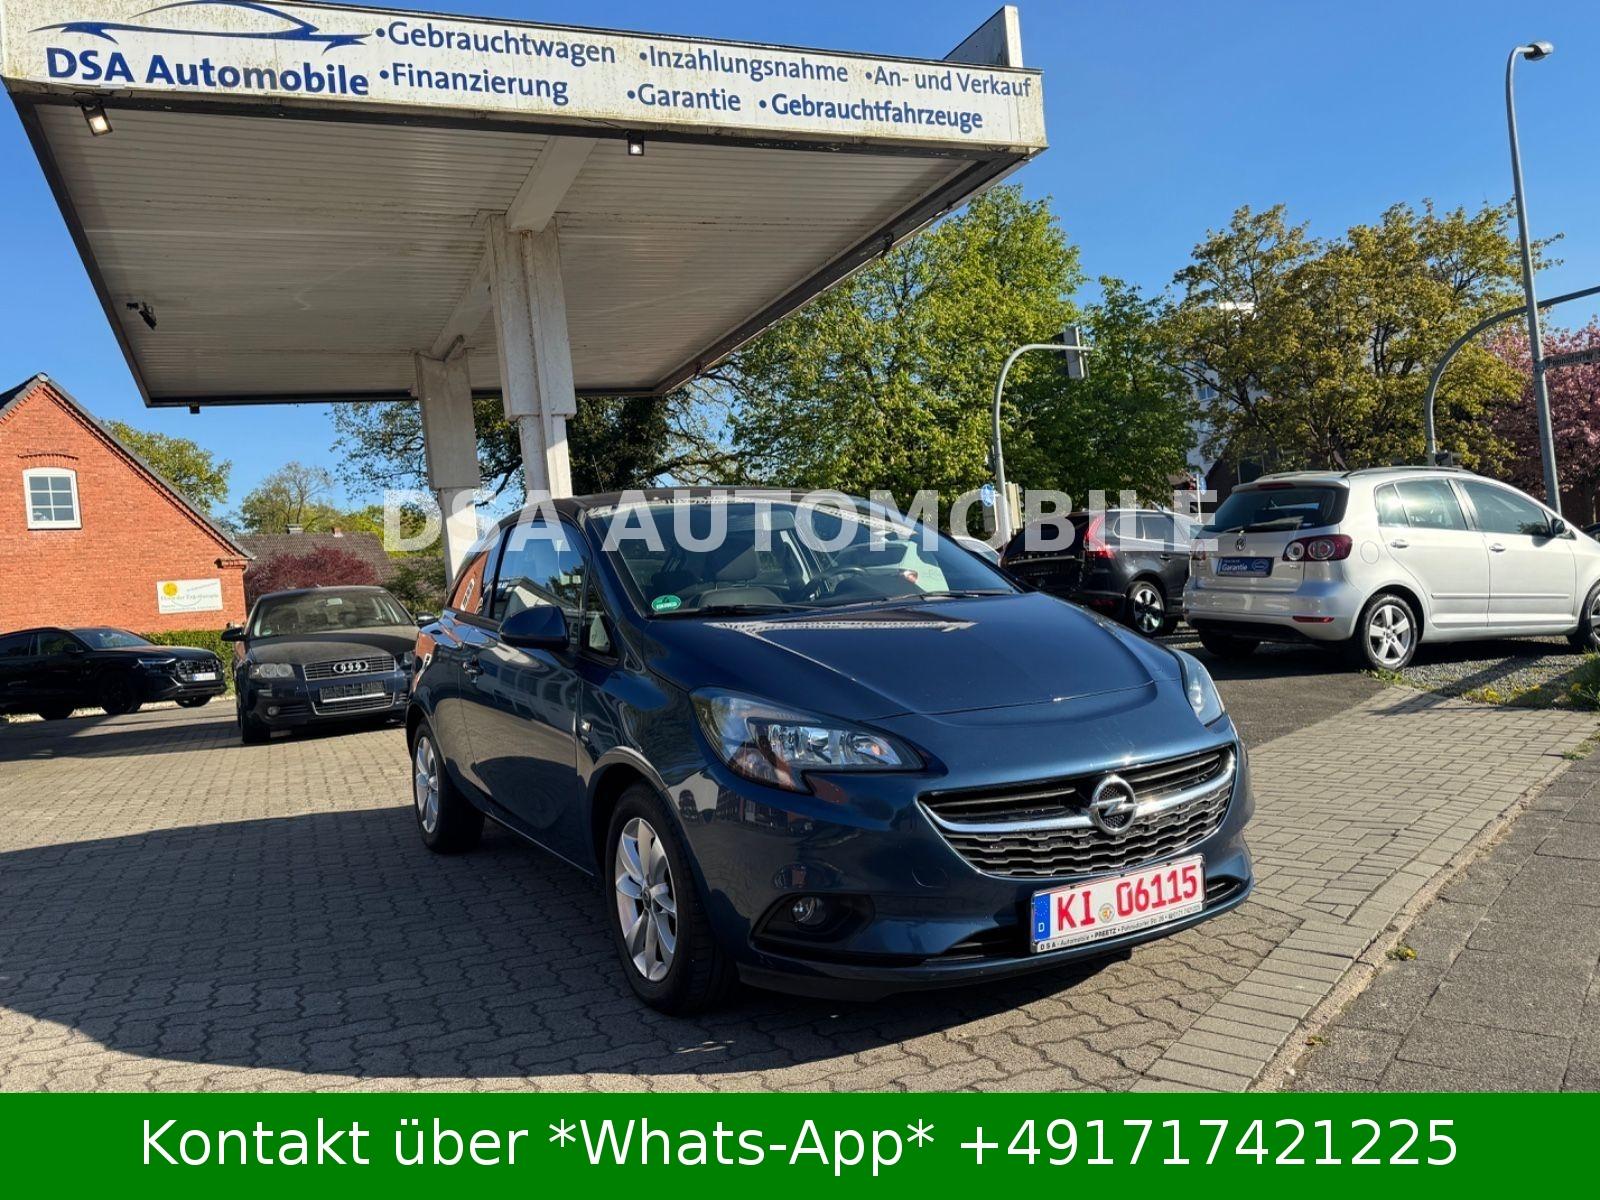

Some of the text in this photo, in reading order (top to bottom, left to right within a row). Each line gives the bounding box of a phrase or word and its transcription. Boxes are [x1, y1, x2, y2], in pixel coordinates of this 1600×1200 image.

[389, 21, 616, 68] Gebrauchtwagen
[47, 47, 369, 96] DSA Automobile
[393, 62, 569, 105] Finanzierung
[649, 46, 848, 84] Inzahlungsnahme
[874, 66, 1031, 97] An- und Verkauf
[638, 83, 741, 112] Garantie
[771, 93, 983, 133] Gebrauchtfahrzeuge
[1222, 562, 1248, 572] Garantie
[1057, 864, 1199, 931] KI 06115
[1038, 922, 1045, 933] D
